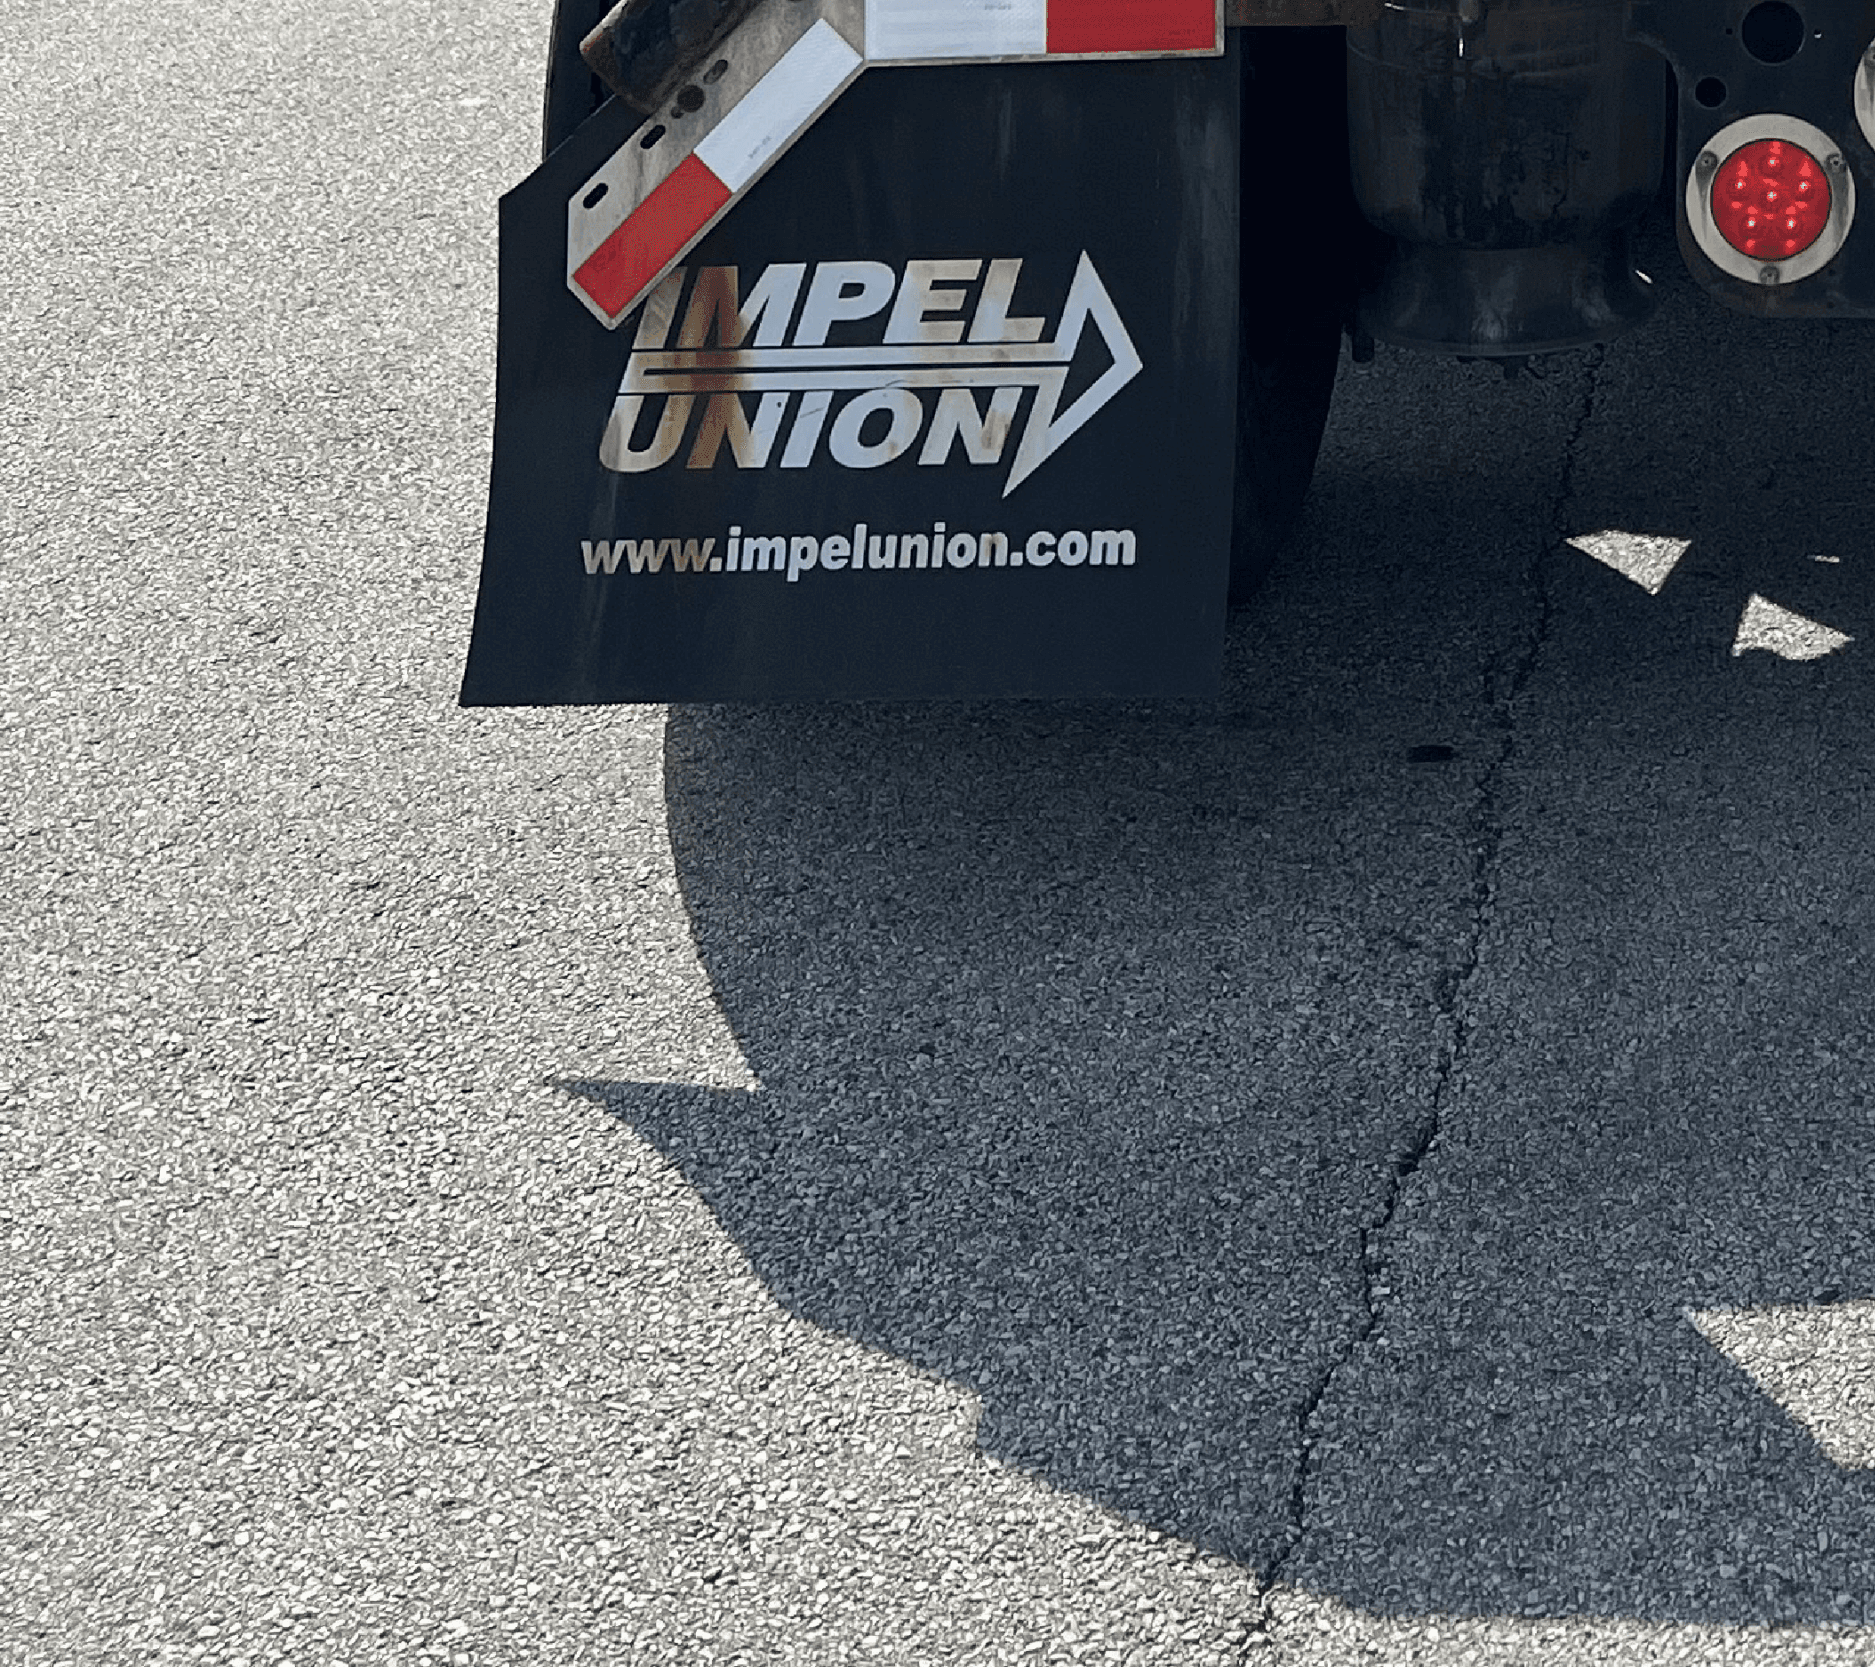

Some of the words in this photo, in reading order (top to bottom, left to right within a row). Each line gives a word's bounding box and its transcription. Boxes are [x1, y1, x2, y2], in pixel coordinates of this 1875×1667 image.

[631, 258, 1046, 349] IMPEL
[599, 386, 1024, 473] UNION
[581, 522, 1137, 583] www.impelunion.com
